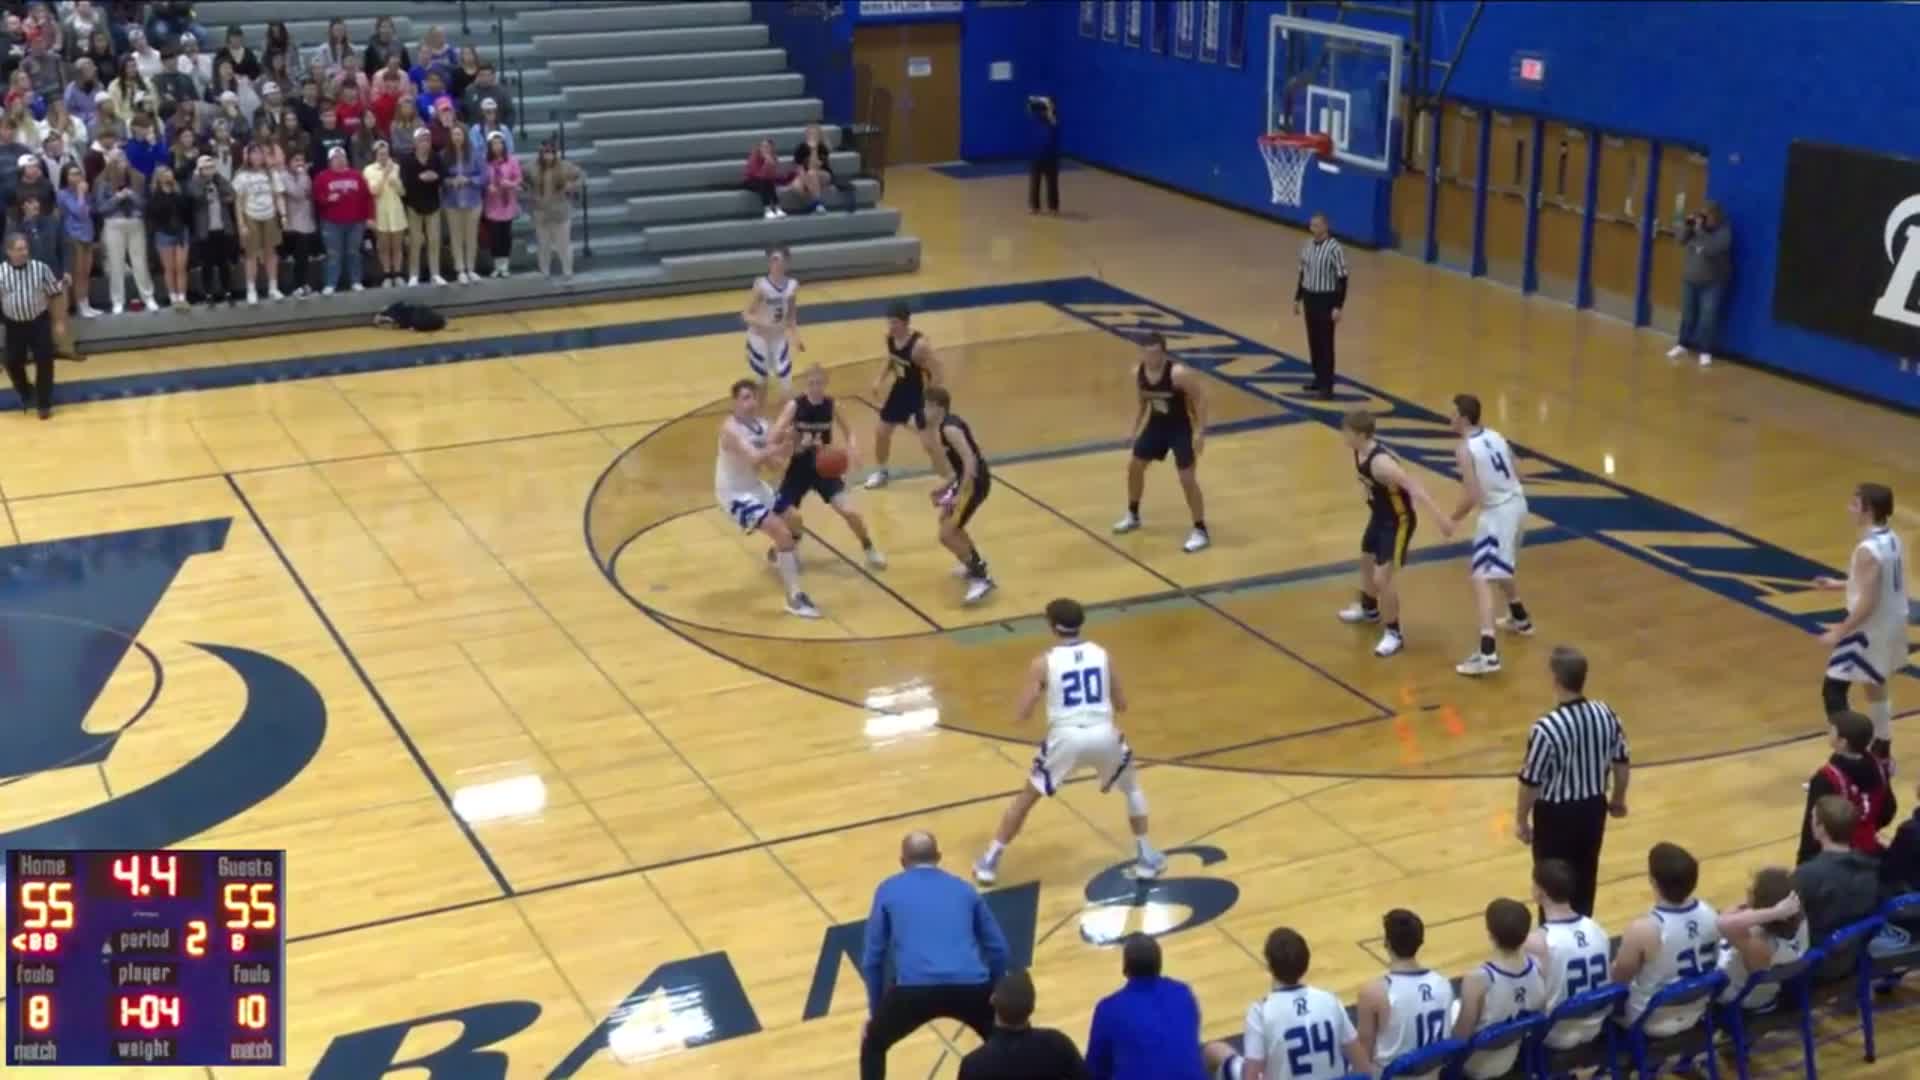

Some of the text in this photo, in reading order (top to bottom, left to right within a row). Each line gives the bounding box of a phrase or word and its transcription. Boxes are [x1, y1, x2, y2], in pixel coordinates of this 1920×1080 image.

[1490, 451, 1510, 479] 4
[1061, 667, 1103, 707] 20
[1567, 953, 1608, 996] 22
[1283, 1020, 1335, 1077] 24
